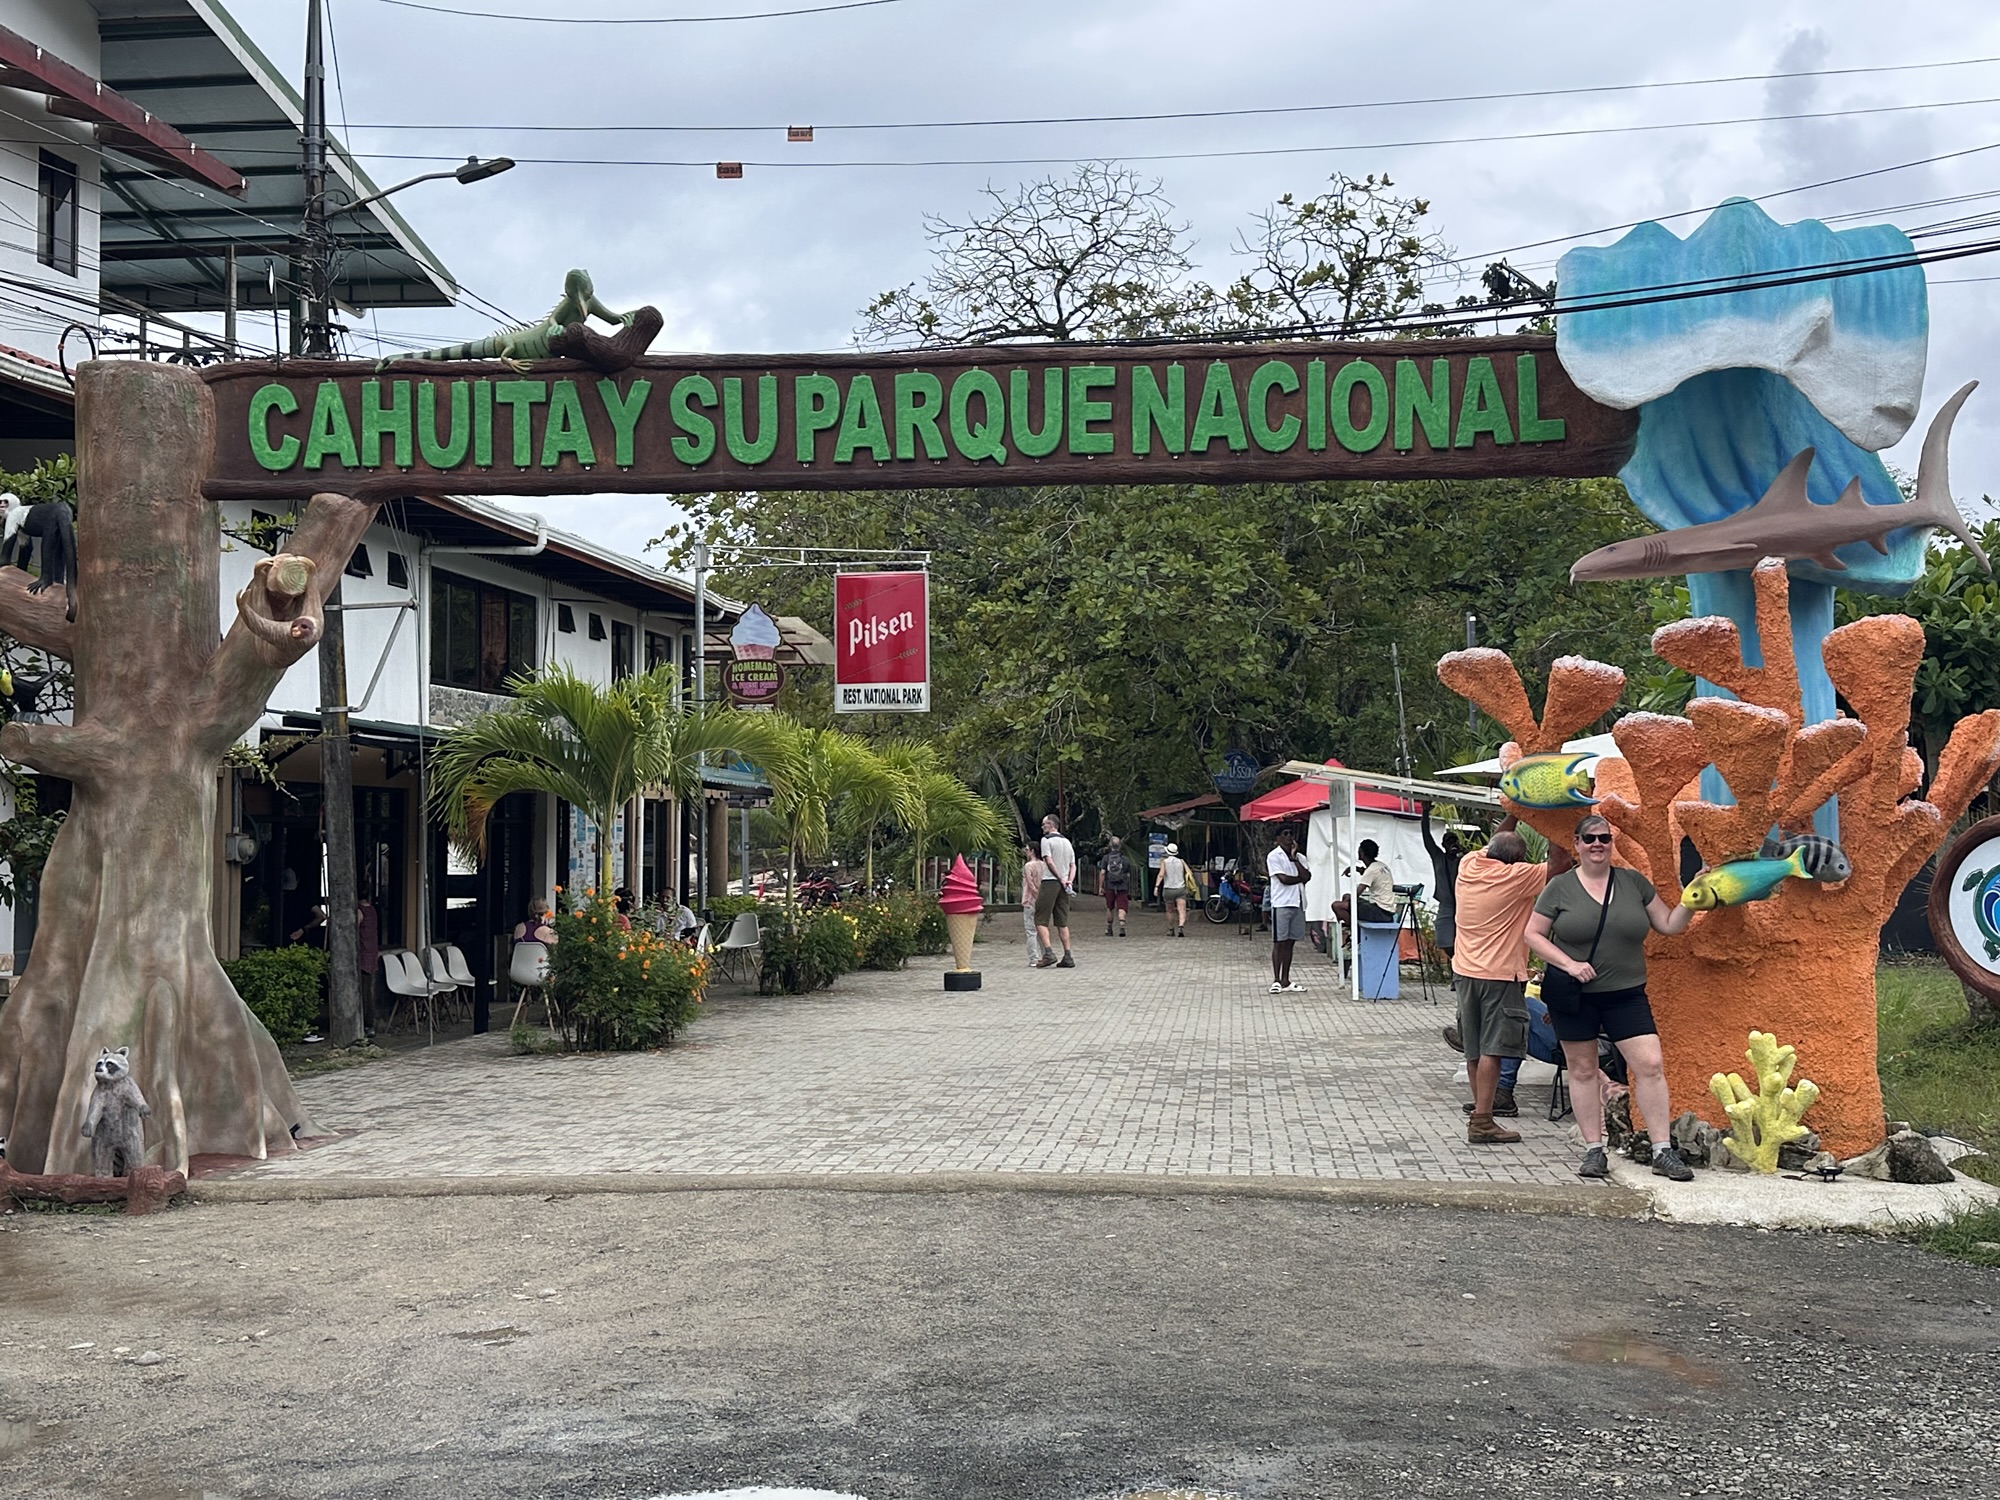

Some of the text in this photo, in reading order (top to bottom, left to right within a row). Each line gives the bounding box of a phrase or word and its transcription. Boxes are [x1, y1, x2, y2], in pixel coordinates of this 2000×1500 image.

[248, 353, 1566, 471] CAHUITA Y SU PARQUE NACIONAL
[848, 610, 914, 657] Pilsen
[732, 661, 778, 673] HOMEMADE
[731, 673, 778, 682] ICE CREAM
[842, 688, 923, 705] REST. NATIONAL PARK
